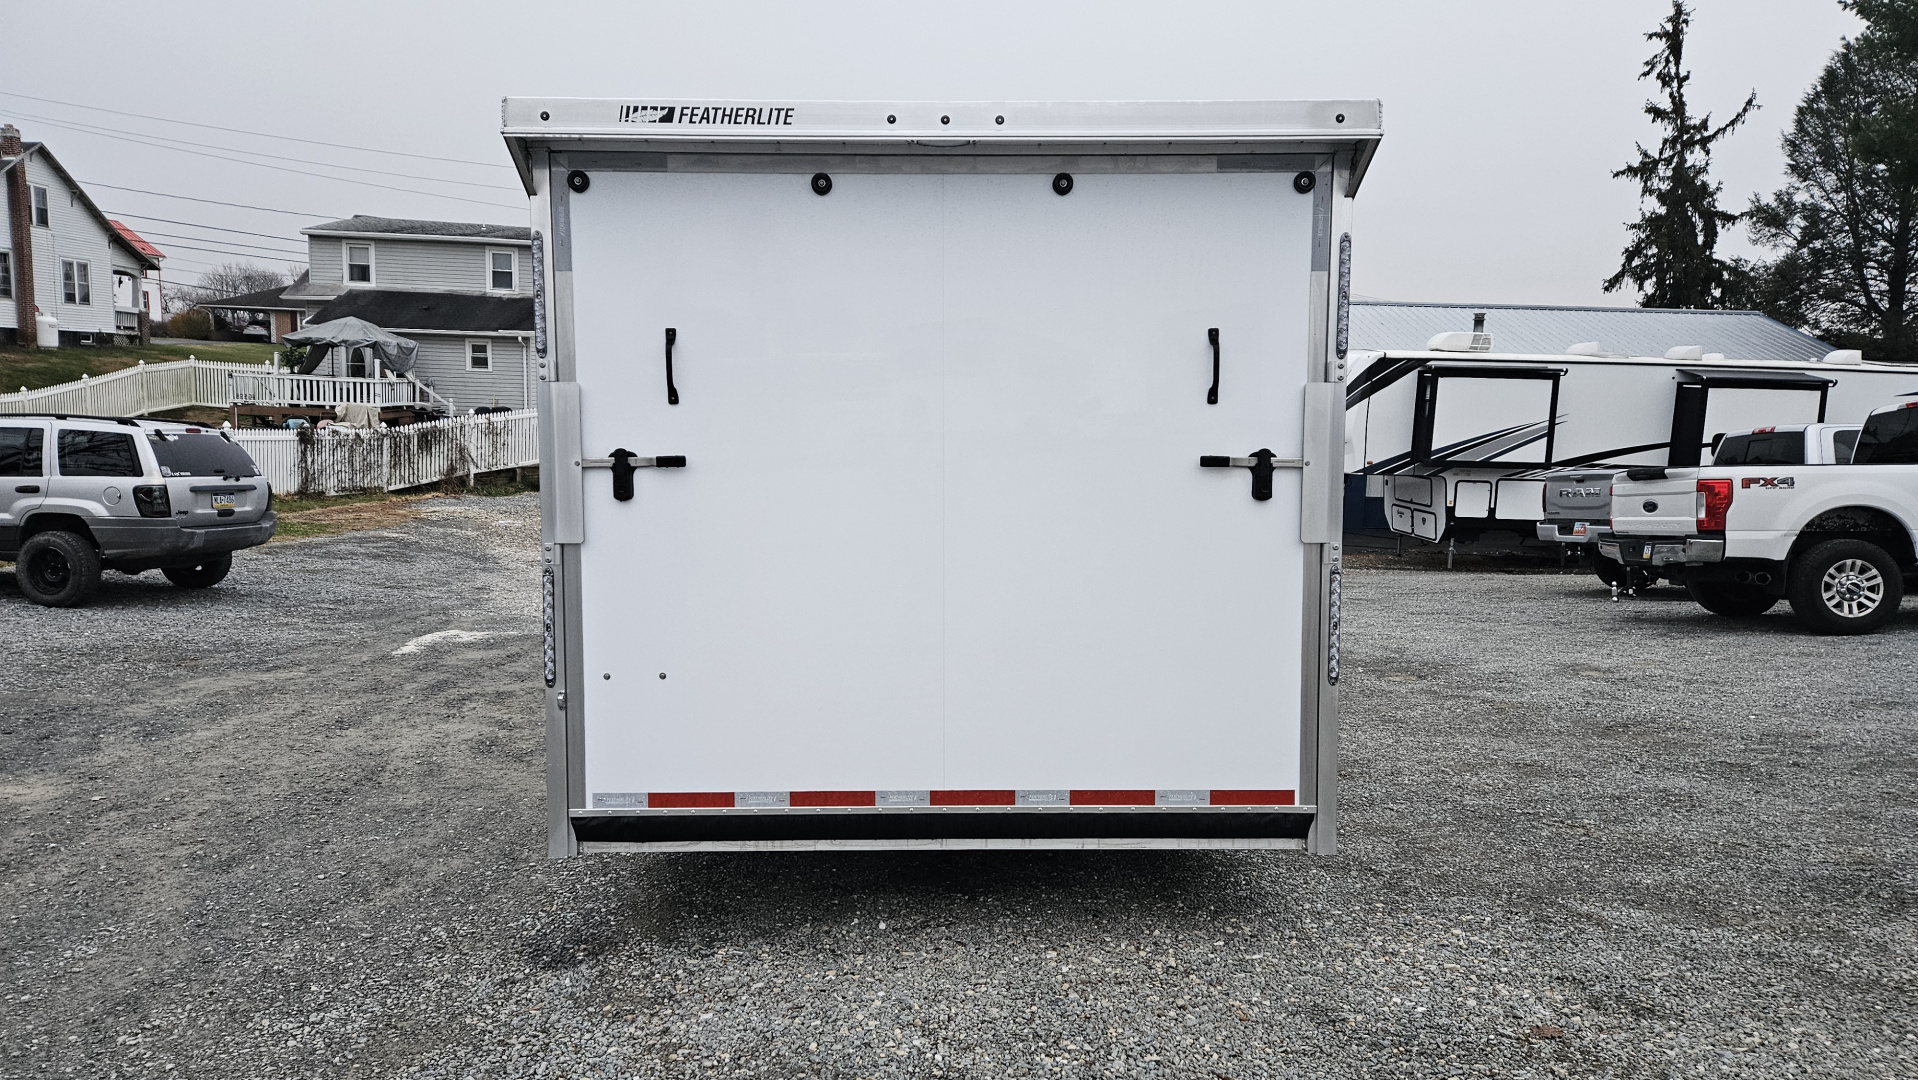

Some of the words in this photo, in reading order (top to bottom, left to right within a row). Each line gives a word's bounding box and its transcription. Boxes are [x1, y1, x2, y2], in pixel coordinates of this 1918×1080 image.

[678, 106, 795, 125] FEATHERLITE
[1741, 477, 1795, 489] FX4
[1559, 487, 1601, 498] RAM
